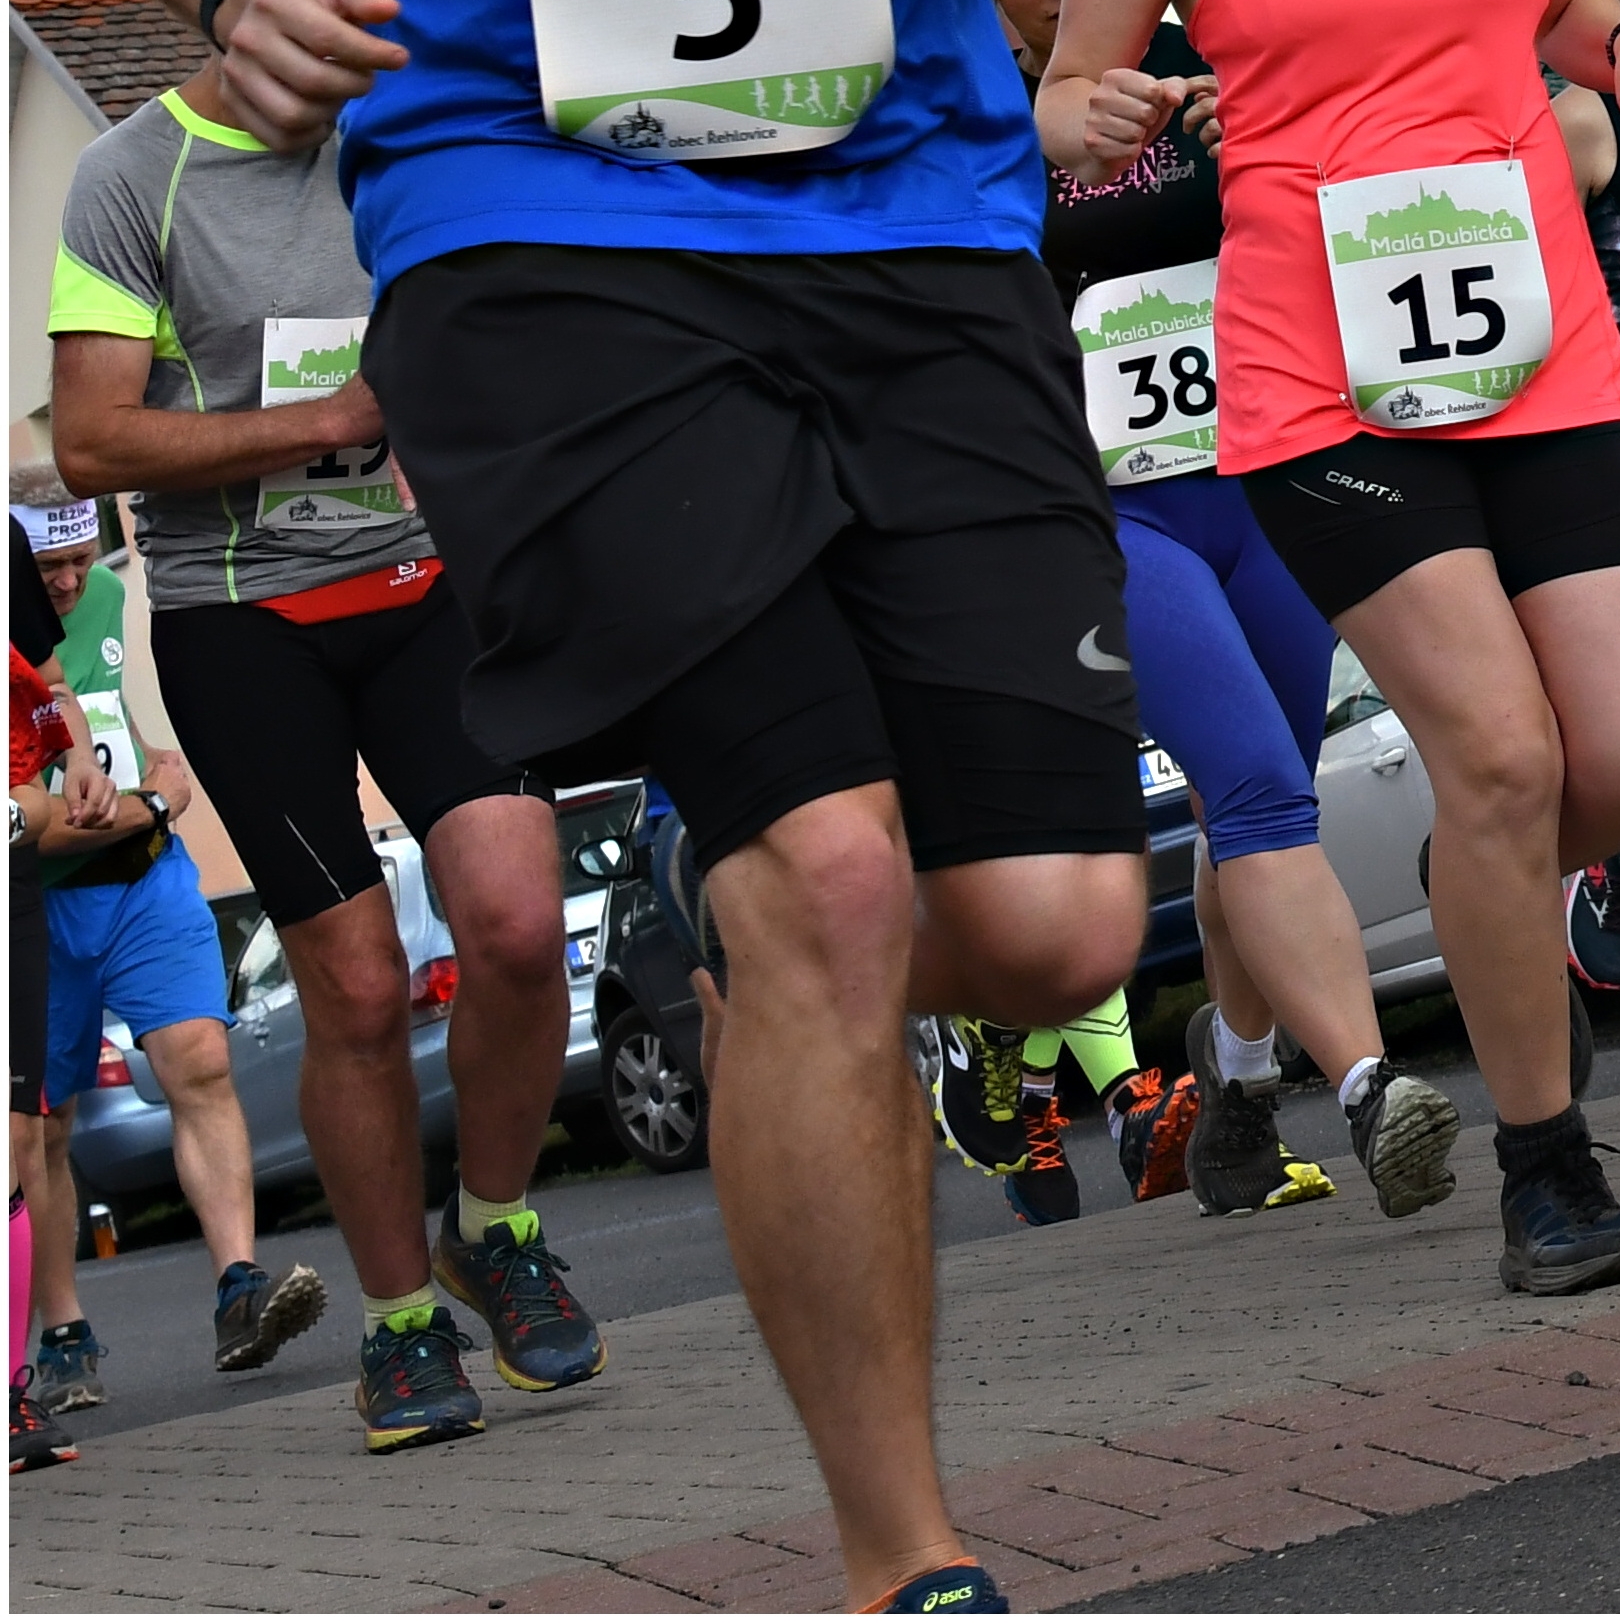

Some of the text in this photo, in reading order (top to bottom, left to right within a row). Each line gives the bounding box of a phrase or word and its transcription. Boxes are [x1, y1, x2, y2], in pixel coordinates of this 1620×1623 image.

[668, 125, 778, 149] obec Řehlovice
[1369, 222, 1513, 256] Malá Dubická
[1387, 264, 1507, 364] 15
[1104, 324, 1149, 346] Malá
[300, 369, 347, 387] Malá
[1117, 345, 1218, 430] 38
[1424, 404, 1446, 418] obec
[1325, 470, 1391, 497] CRAFT
[938, 1585, 973, 1605] asics
